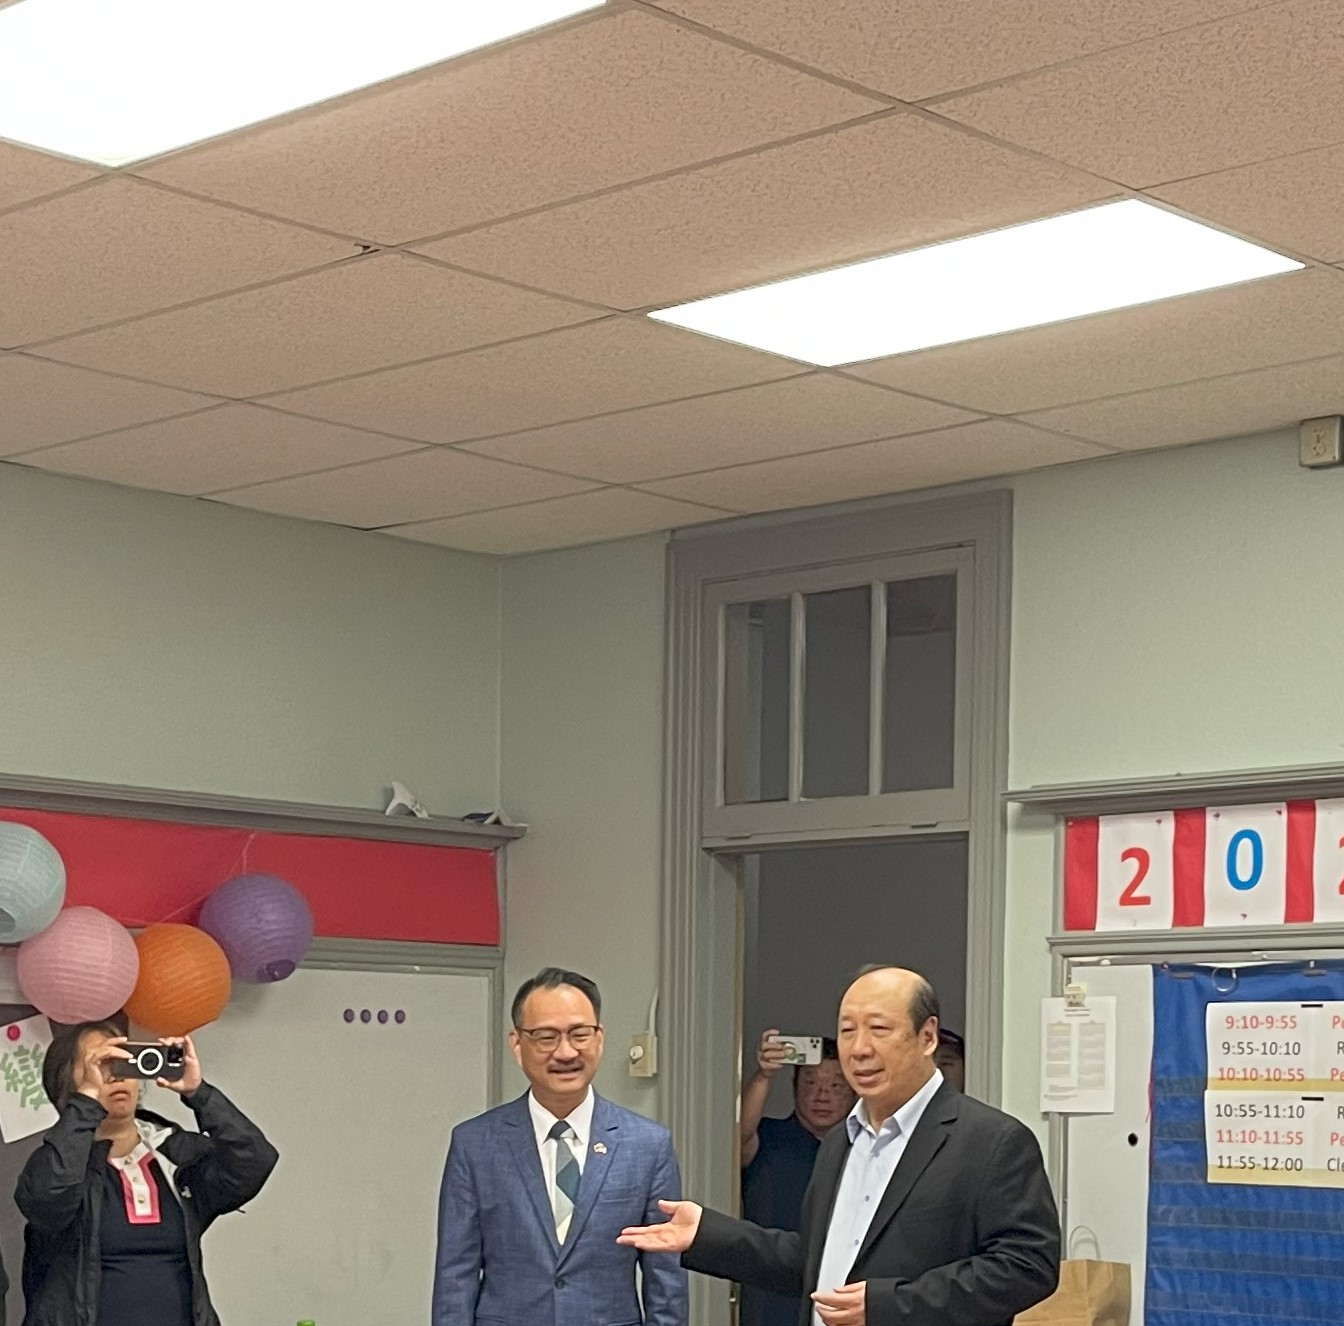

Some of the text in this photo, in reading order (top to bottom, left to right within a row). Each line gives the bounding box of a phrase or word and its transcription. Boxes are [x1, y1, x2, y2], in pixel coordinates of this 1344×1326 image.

[1225, 1015, 1297, 1029] 9:10-9:55
[1221, 1041, 1301, 1055] 9:55-10:10
[1218, 1067, 1305, 1082] 10:10-10:55
[1215, 1103, 1305, 1119] 10:55-11:10
[1217, 1129, 1303, 1145] 11:10-11:55
[1217, 1155, 1303, 1171] 11:55-12:00
